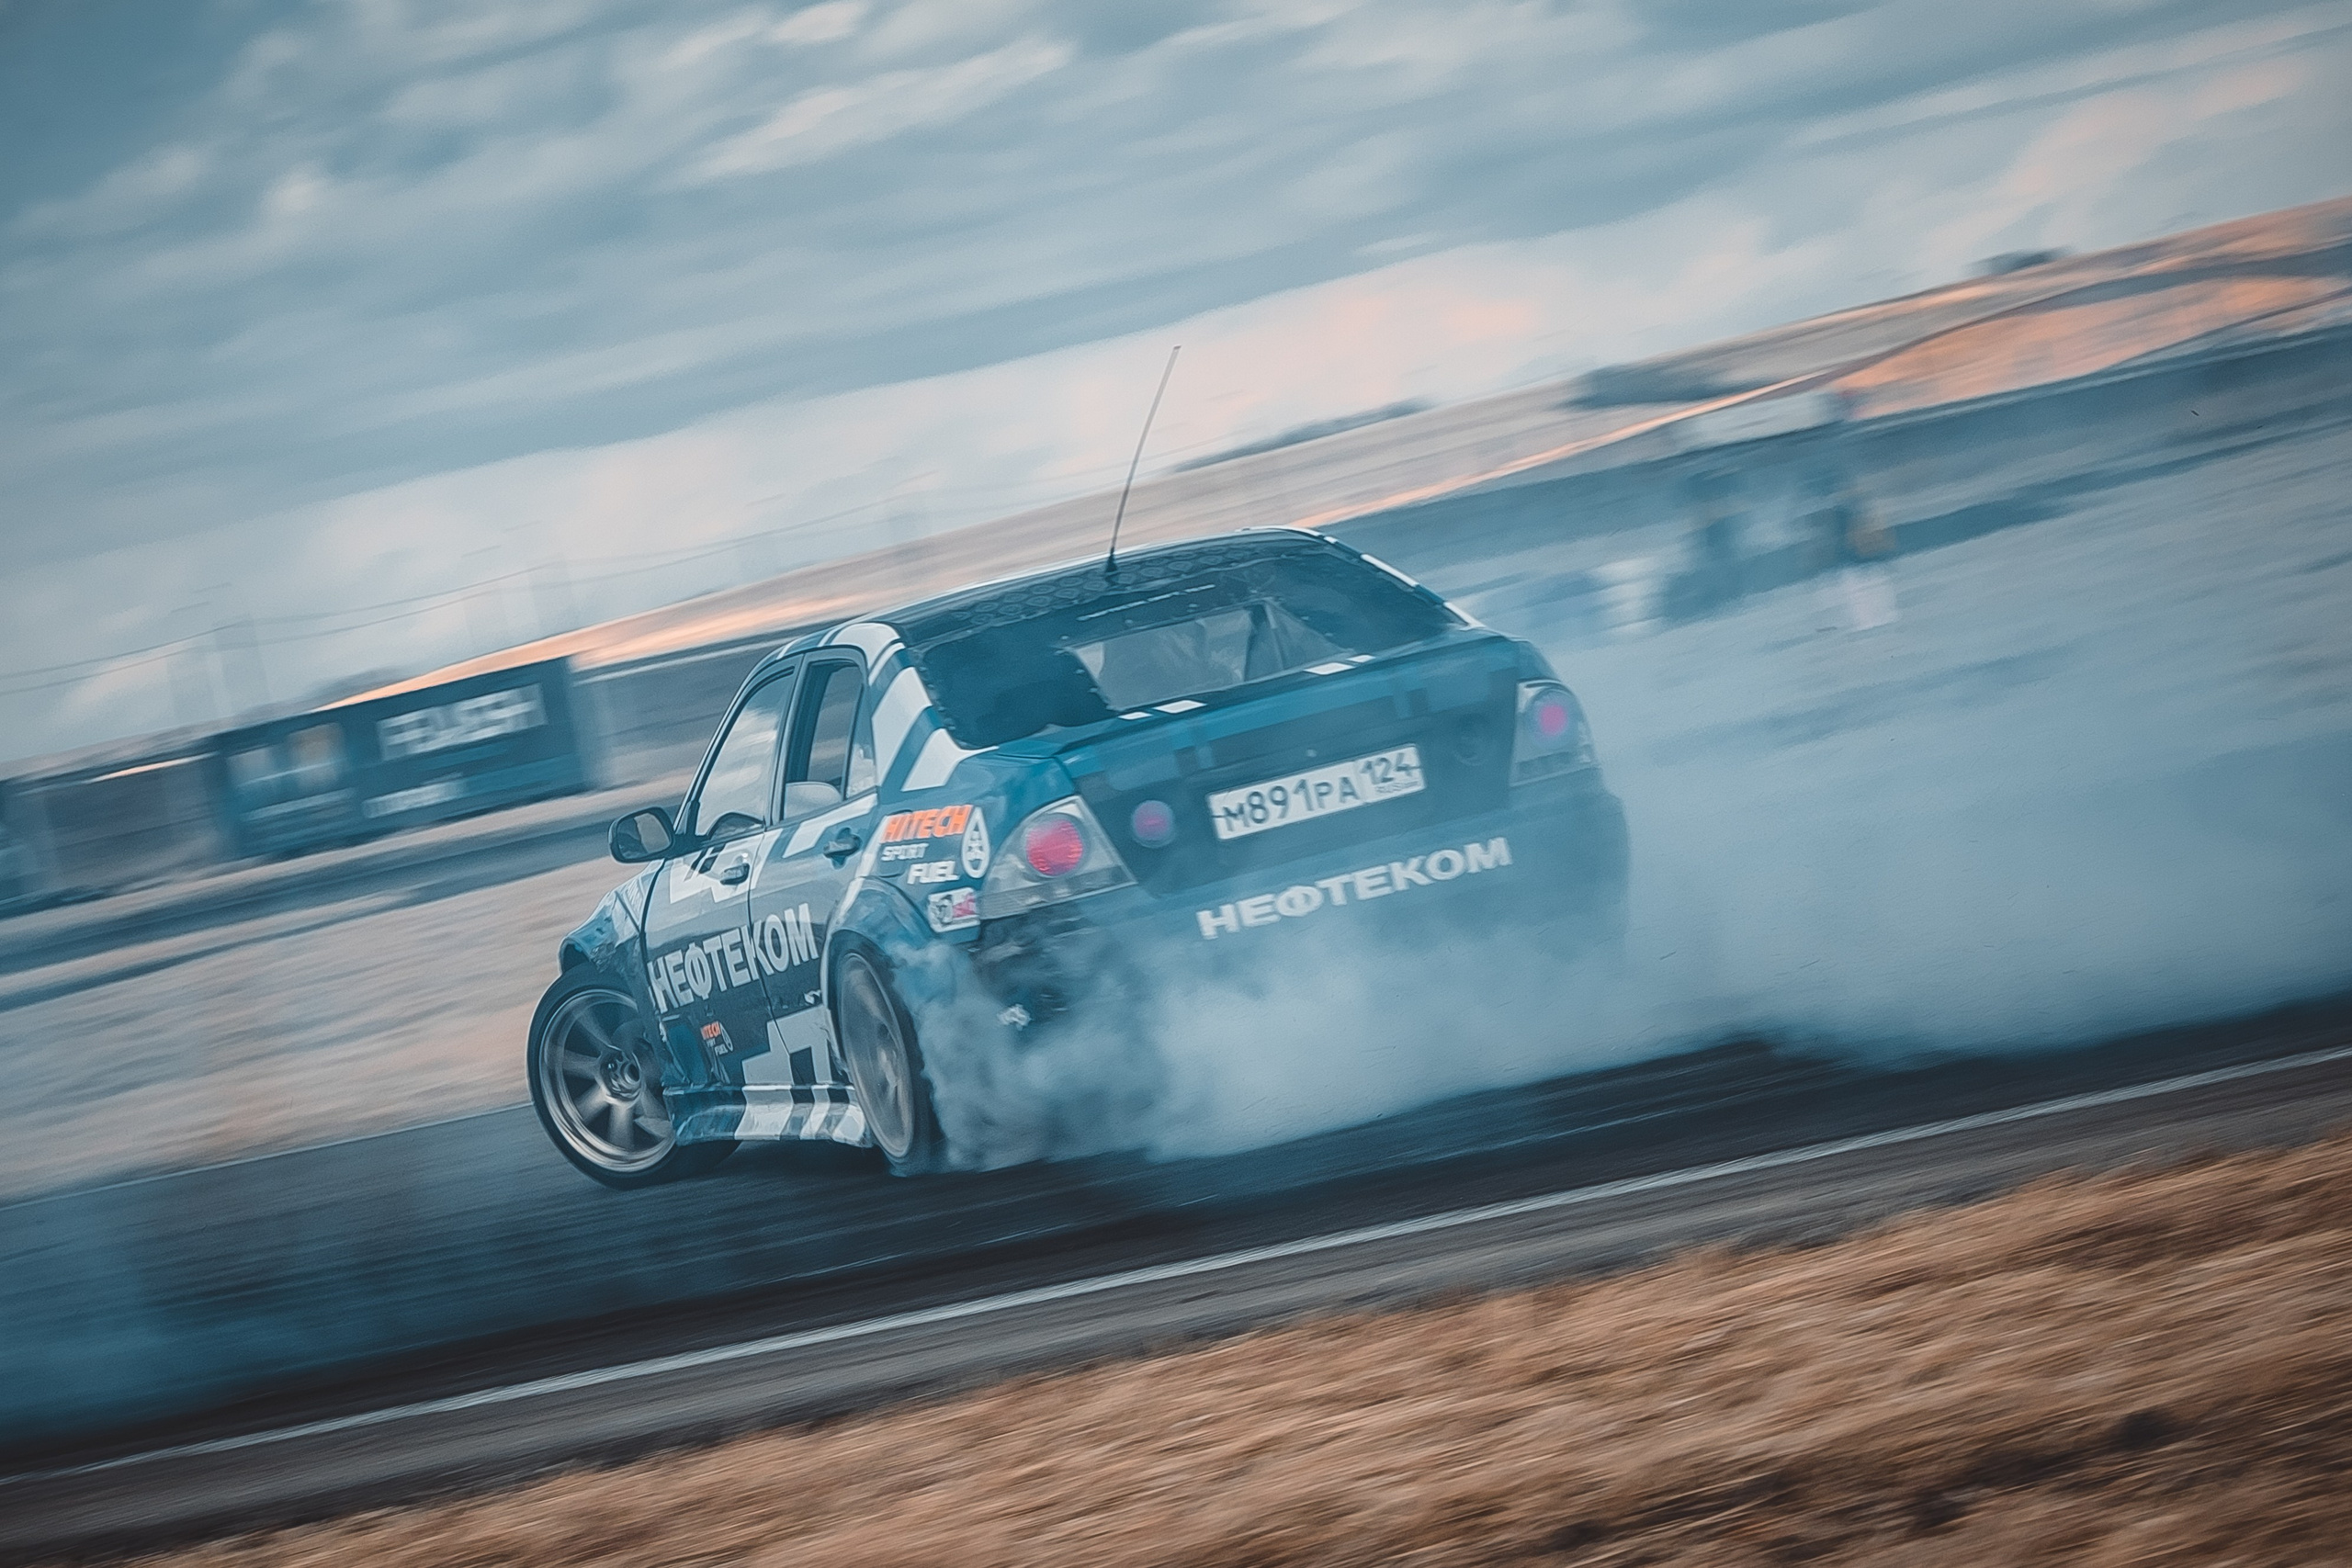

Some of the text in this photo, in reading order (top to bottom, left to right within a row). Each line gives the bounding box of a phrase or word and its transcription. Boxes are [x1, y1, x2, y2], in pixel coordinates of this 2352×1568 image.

[1360, 751, 1414, 785] 124
[879, 804, 974, 844] HITECH
[907, 861, 961, 885] FUEL
[1195, 837, 1513, 940] НЕФТЕКОМ
[647, 903, 820, 1014] НЕФТЕКОМ
